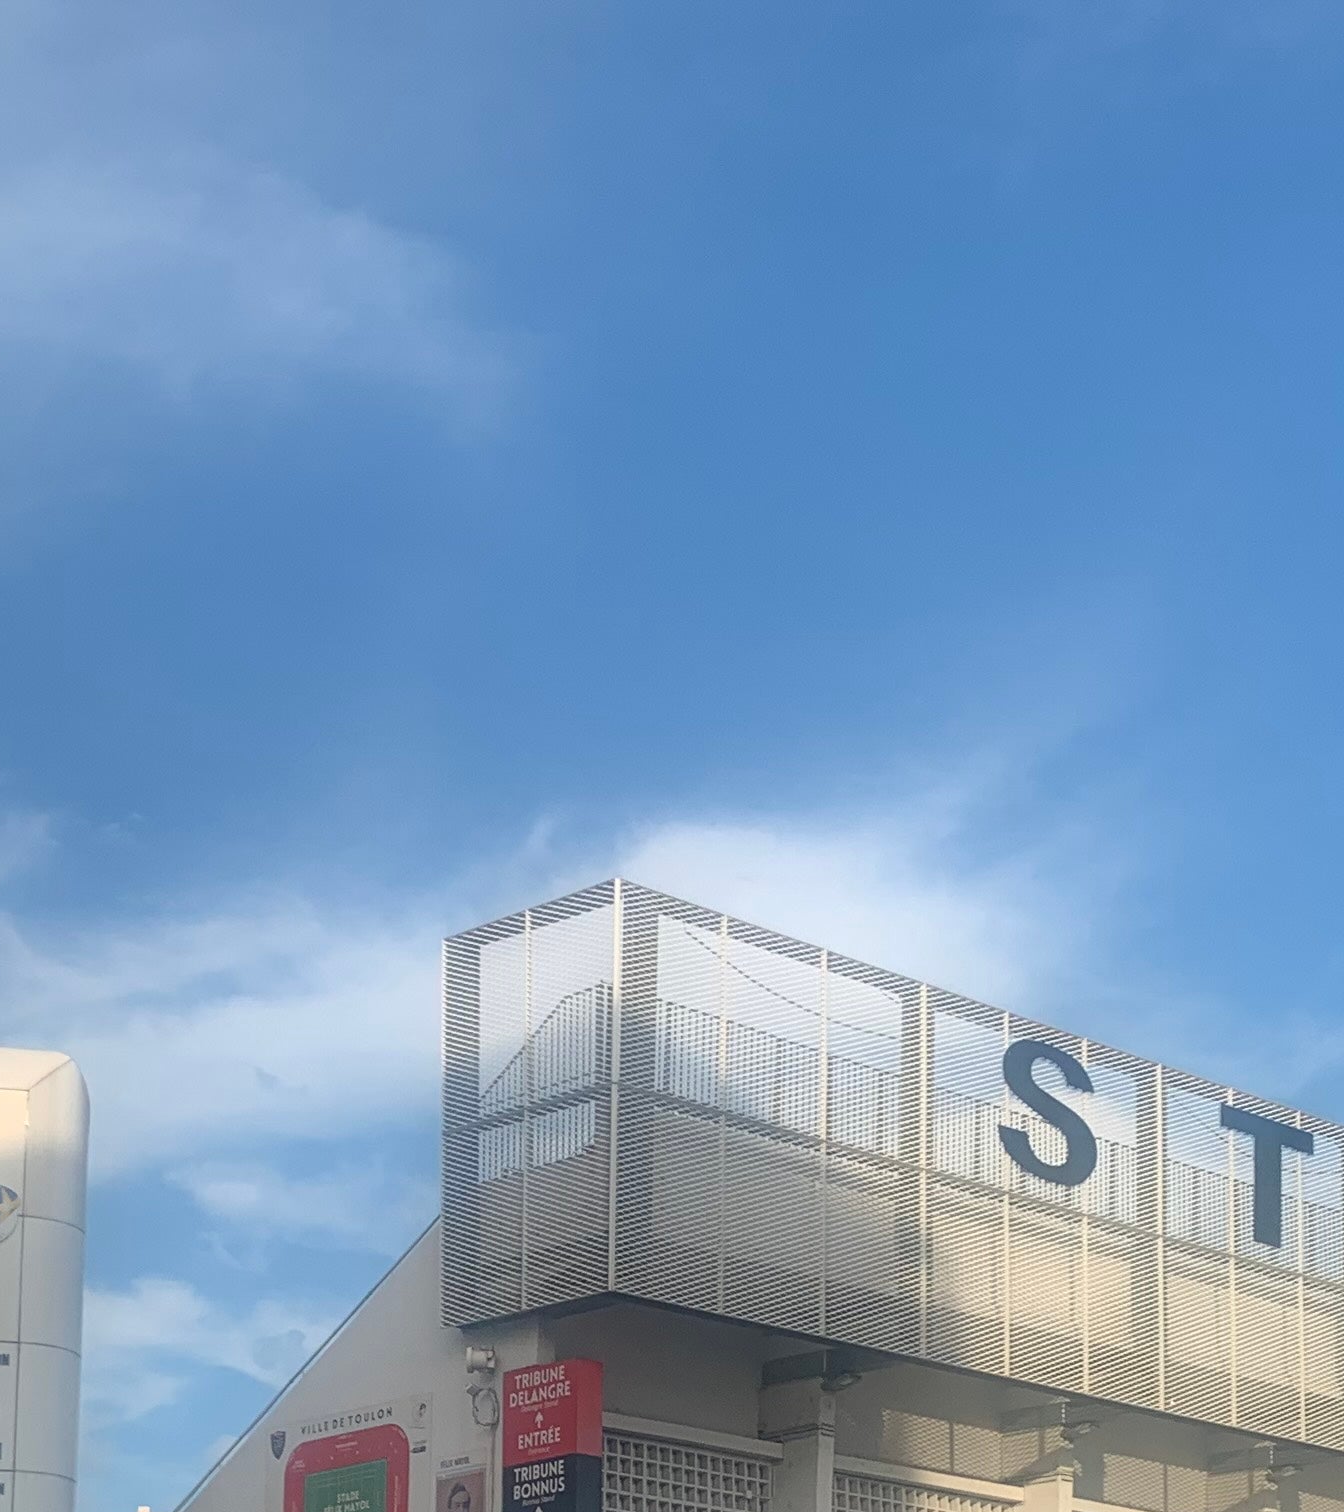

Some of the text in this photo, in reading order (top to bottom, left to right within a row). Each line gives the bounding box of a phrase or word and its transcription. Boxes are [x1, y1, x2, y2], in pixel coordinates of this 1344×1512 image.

[514, 1365, 566, 1390] TRIBUNE
[509, 1380, 571, 1408] DELANGRE
[300, 1406, 394, 1435] VILLE DE TOULON
[518, 1425, 561, 1450] ENTRÉE
[513, 1459, 565, 1483] TRIBUNE
[513, 1476, 566, 1500] BONNUS
